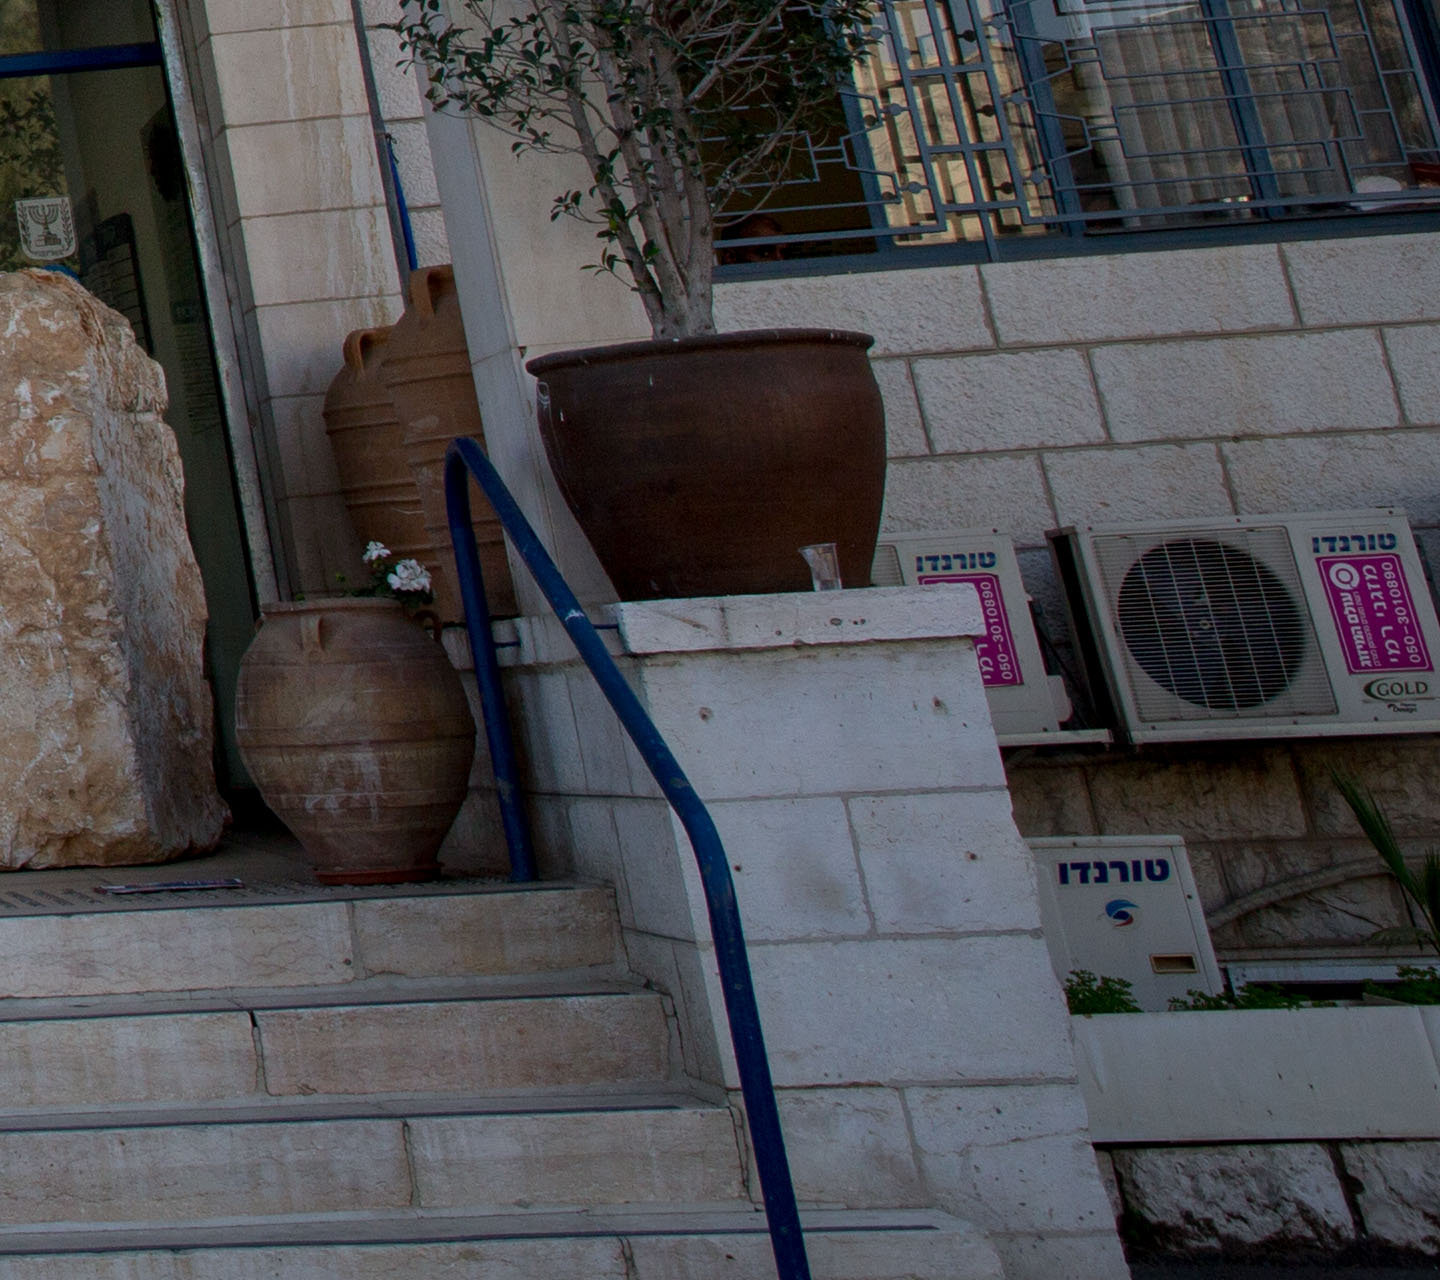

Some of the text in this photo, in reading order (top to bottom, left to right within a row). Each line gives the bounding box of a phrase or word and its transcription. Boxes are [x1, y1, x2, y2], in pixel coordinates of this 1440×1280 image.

[1312, 533, 1397, 553] טורנדו
[916, 551, 996, 572] טורנדו
[1340, 591, 1358, 623] עולם
[1362, 565, 1388, 617] מזגני
[1380, 625, 1401, 662] רמי
[1380, 562, 1421, 663] 050-3010890
[980, 582, 1014, 680] 050-3010890
[1376, 681, 1428, 696] GOLD
[1058, 858, 1170, 885] טורנדו
